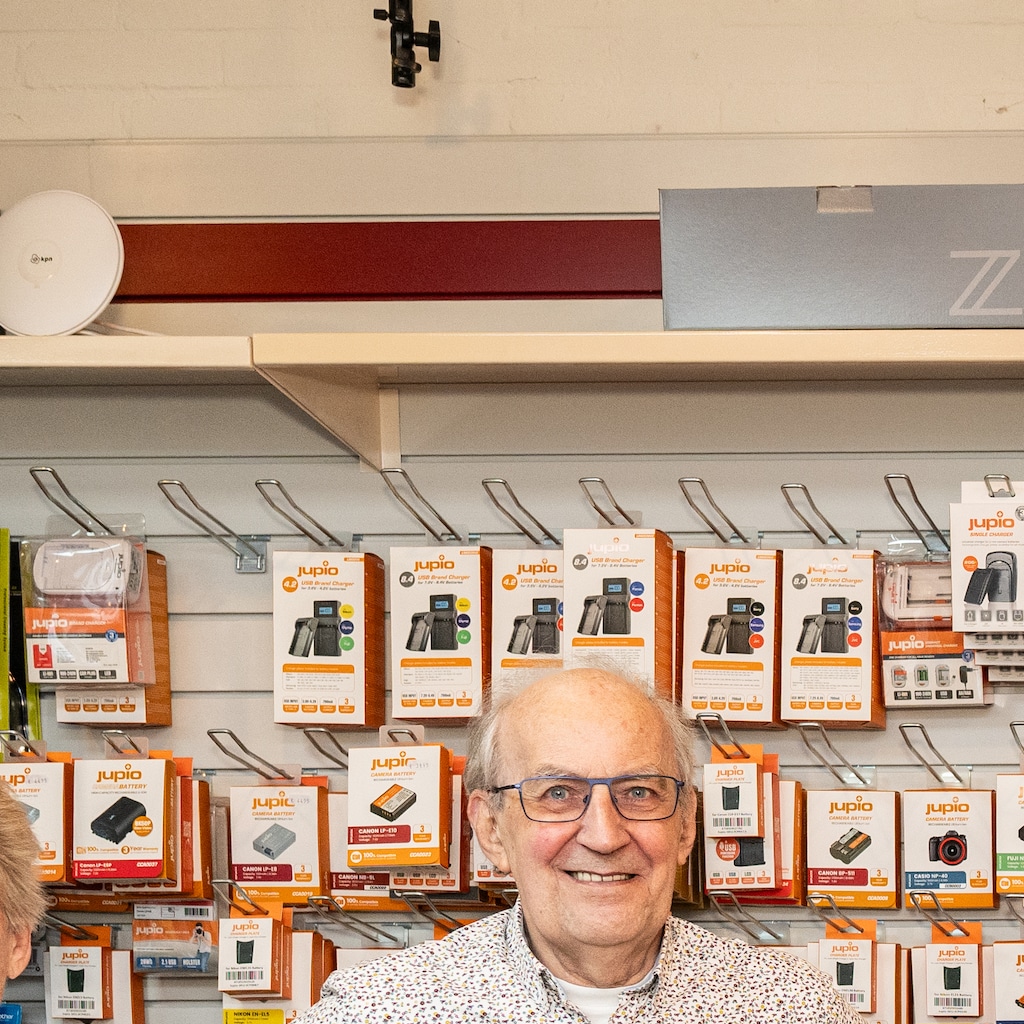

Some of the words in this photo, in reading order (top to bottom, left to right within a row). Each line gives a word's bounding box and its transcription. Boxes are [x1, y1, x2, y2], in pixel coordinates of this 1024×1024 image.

[968, 510, 1015, 531] jupio
[414, 554, 455, 572] jupio
[516, 558, 558, 575] jupio
[573, 555, 588, 565] 8.4
[709, 558, 751, 574] jupio
[297, 560, 339, 577] jupio
[282, 580, 297, 588] 4.2
[400, 576, 415, 584] 8.4
[695, 577, 710, 585] 4.2
[794, 578, 807, 586] 8.4
[32, 613, 68, 630] jupio
[888, 635, 924, 651] jupio
[96, 763, 142, 782] jupio
[717, 765, 744, 777] jupio
[829, 796, 873, 814] jupio
[925, 796, 970, 815] jupio
[136, 922, 164, 935] jupio
[232, 920, 259, 931] jupio
[832, 942, 859, 953] jupio
[938, 946, 965, 957] jupio
[62, 949, 89, 960] jupio
